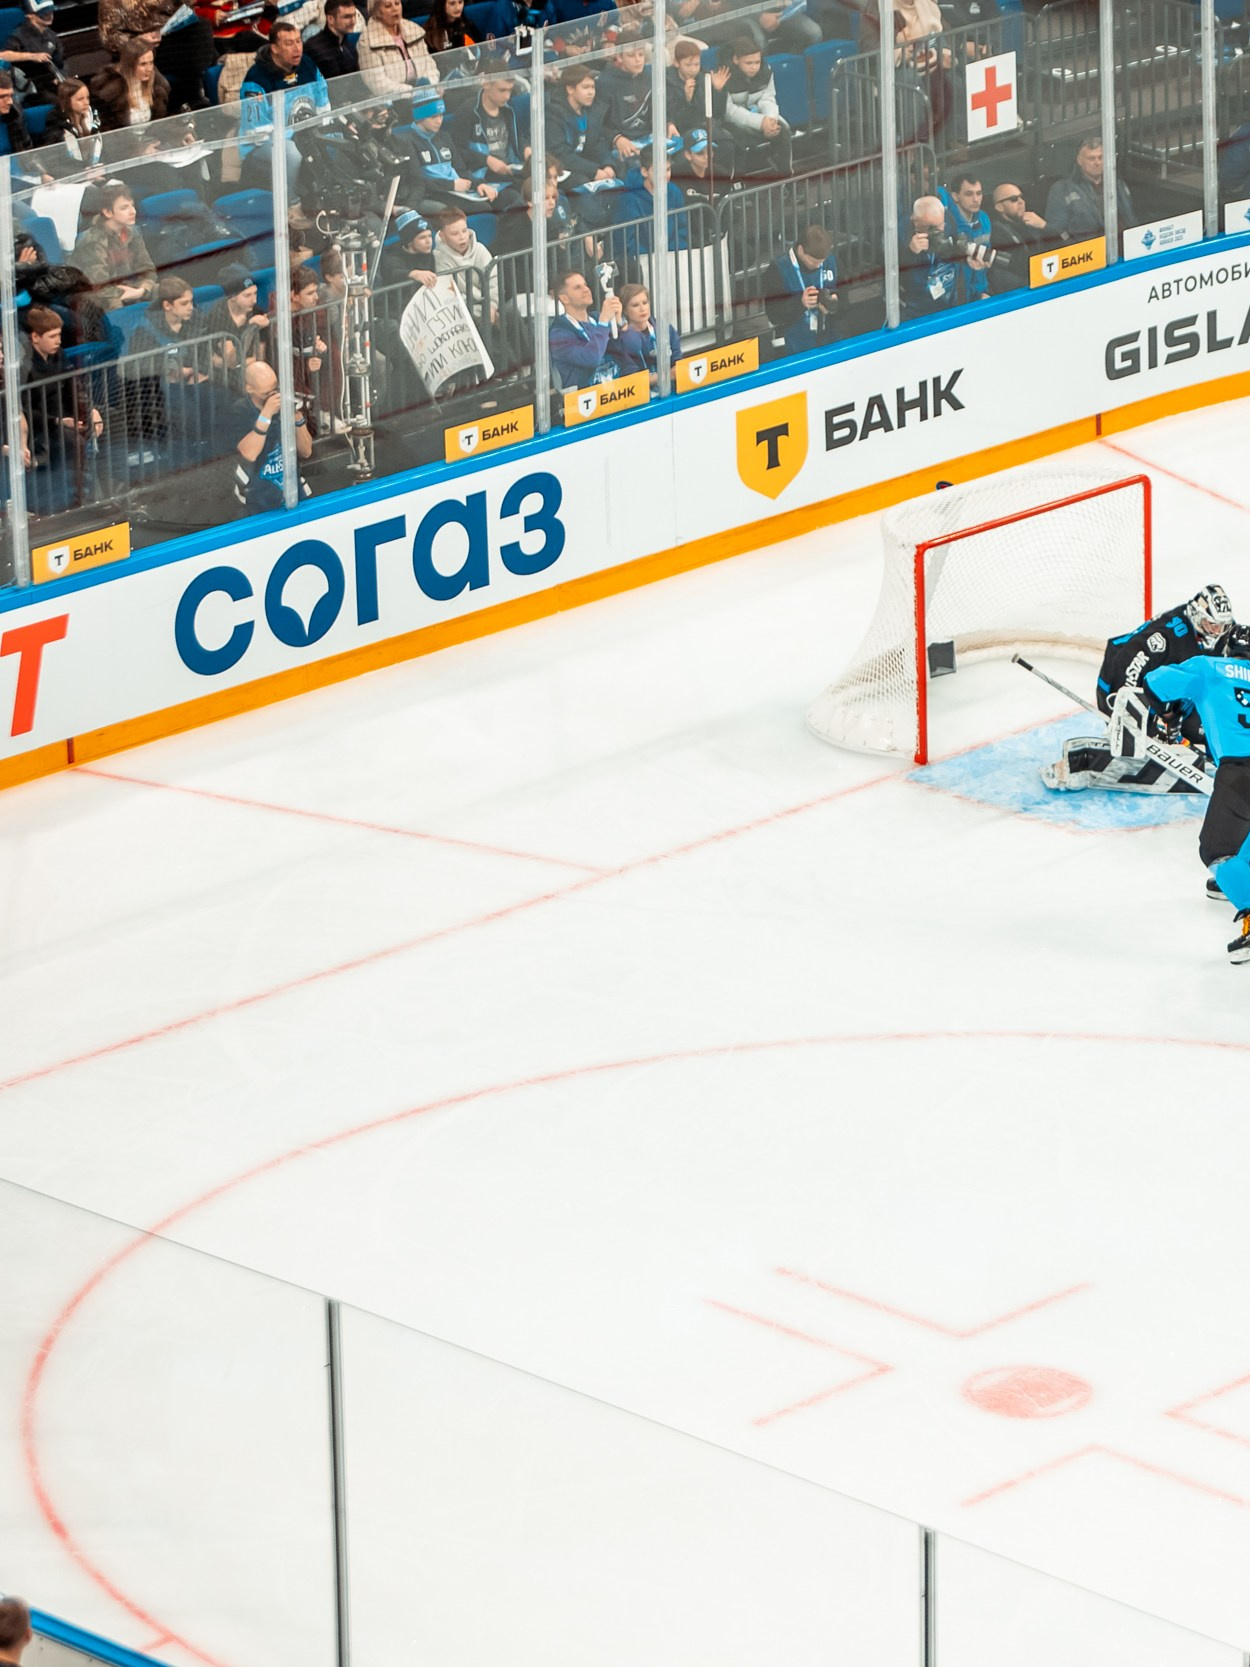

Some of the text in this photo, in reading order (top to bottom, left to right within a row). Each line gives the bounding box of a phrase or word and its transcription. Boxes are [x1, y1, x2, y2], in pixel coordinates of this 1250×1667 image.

[1061, 250, 1094, 270] БАНК
[710, 352, 745, 373] БАНК
[600, 385, 636, 406] БАНК
[756, 368, 966, 470] Т БАНК
[482, 420, 519, 441] БАНК
[73, 540, 113, 561] БАНК
[1146, 744, 1204, 784] BAUER
